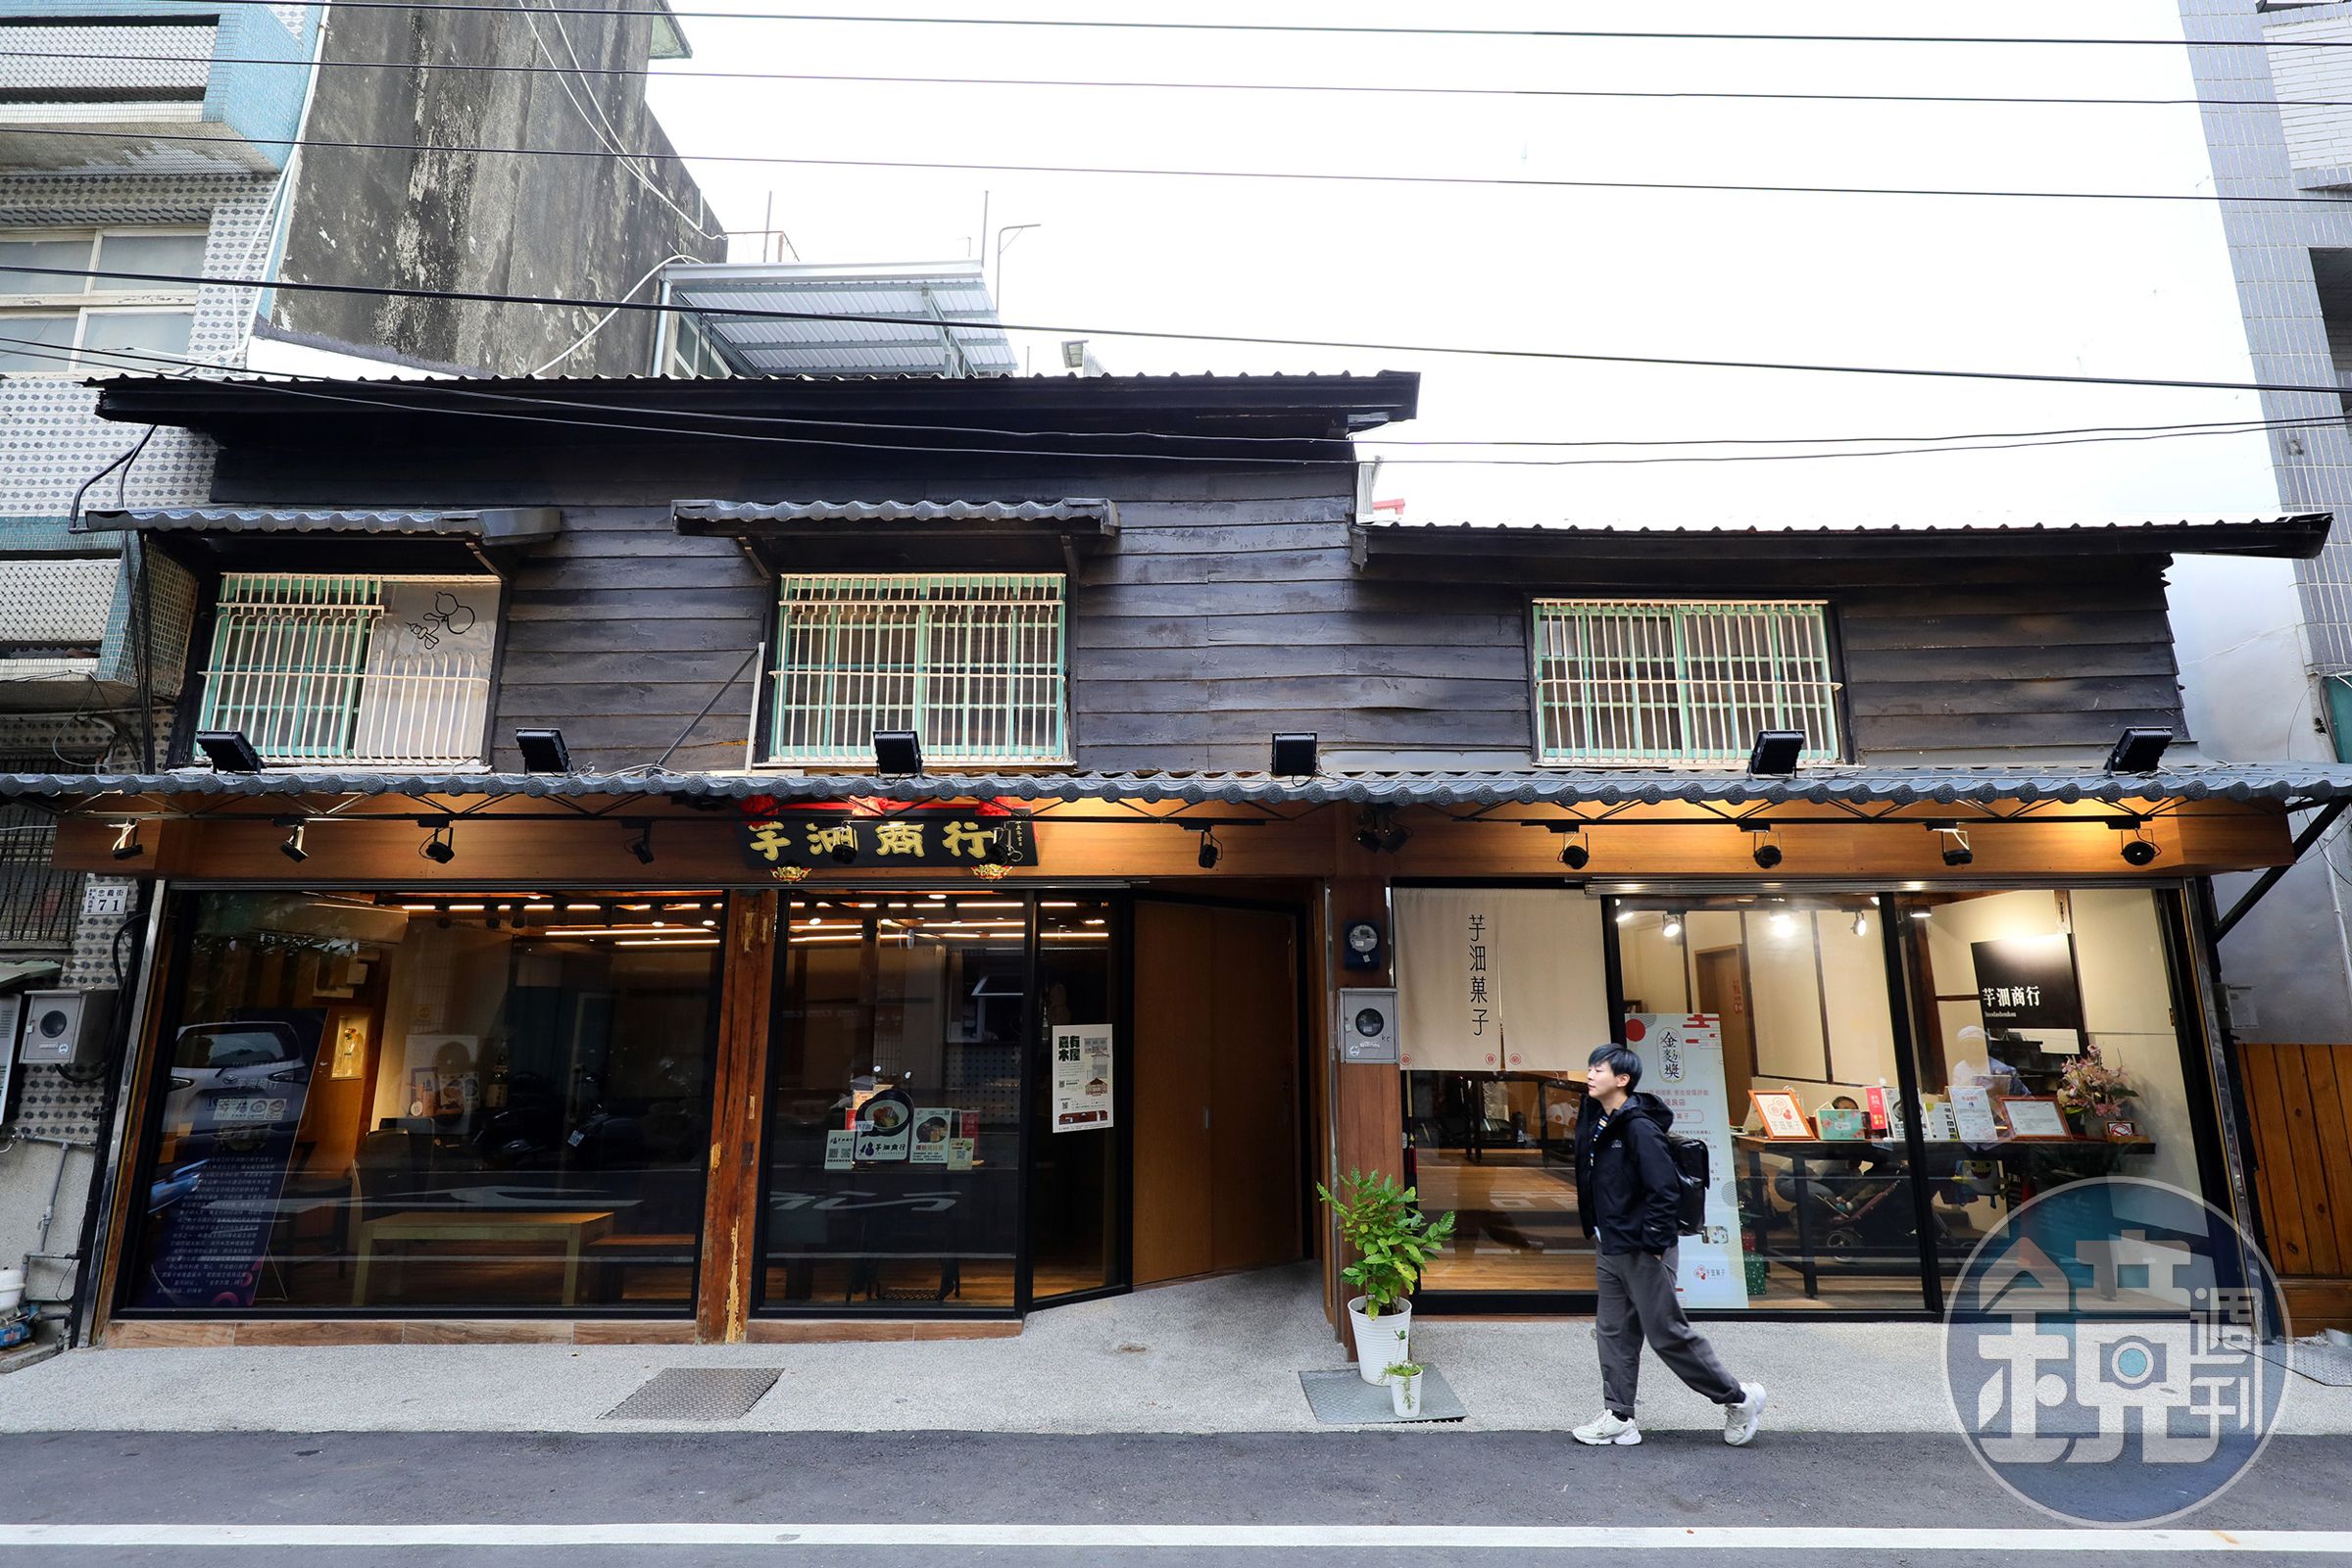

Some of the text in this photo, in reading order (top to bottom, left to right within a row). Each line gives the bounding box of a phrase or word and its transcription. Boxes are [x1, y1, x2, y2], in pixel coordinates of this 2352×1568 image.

[749, 821, 995, 861] 芋沺商行
[98, 899, 120, 912] 71
[1468, 914, 1490, 1036] 芋沺菓子
[1982, 986, 2040, 1007] 芋沺商行
